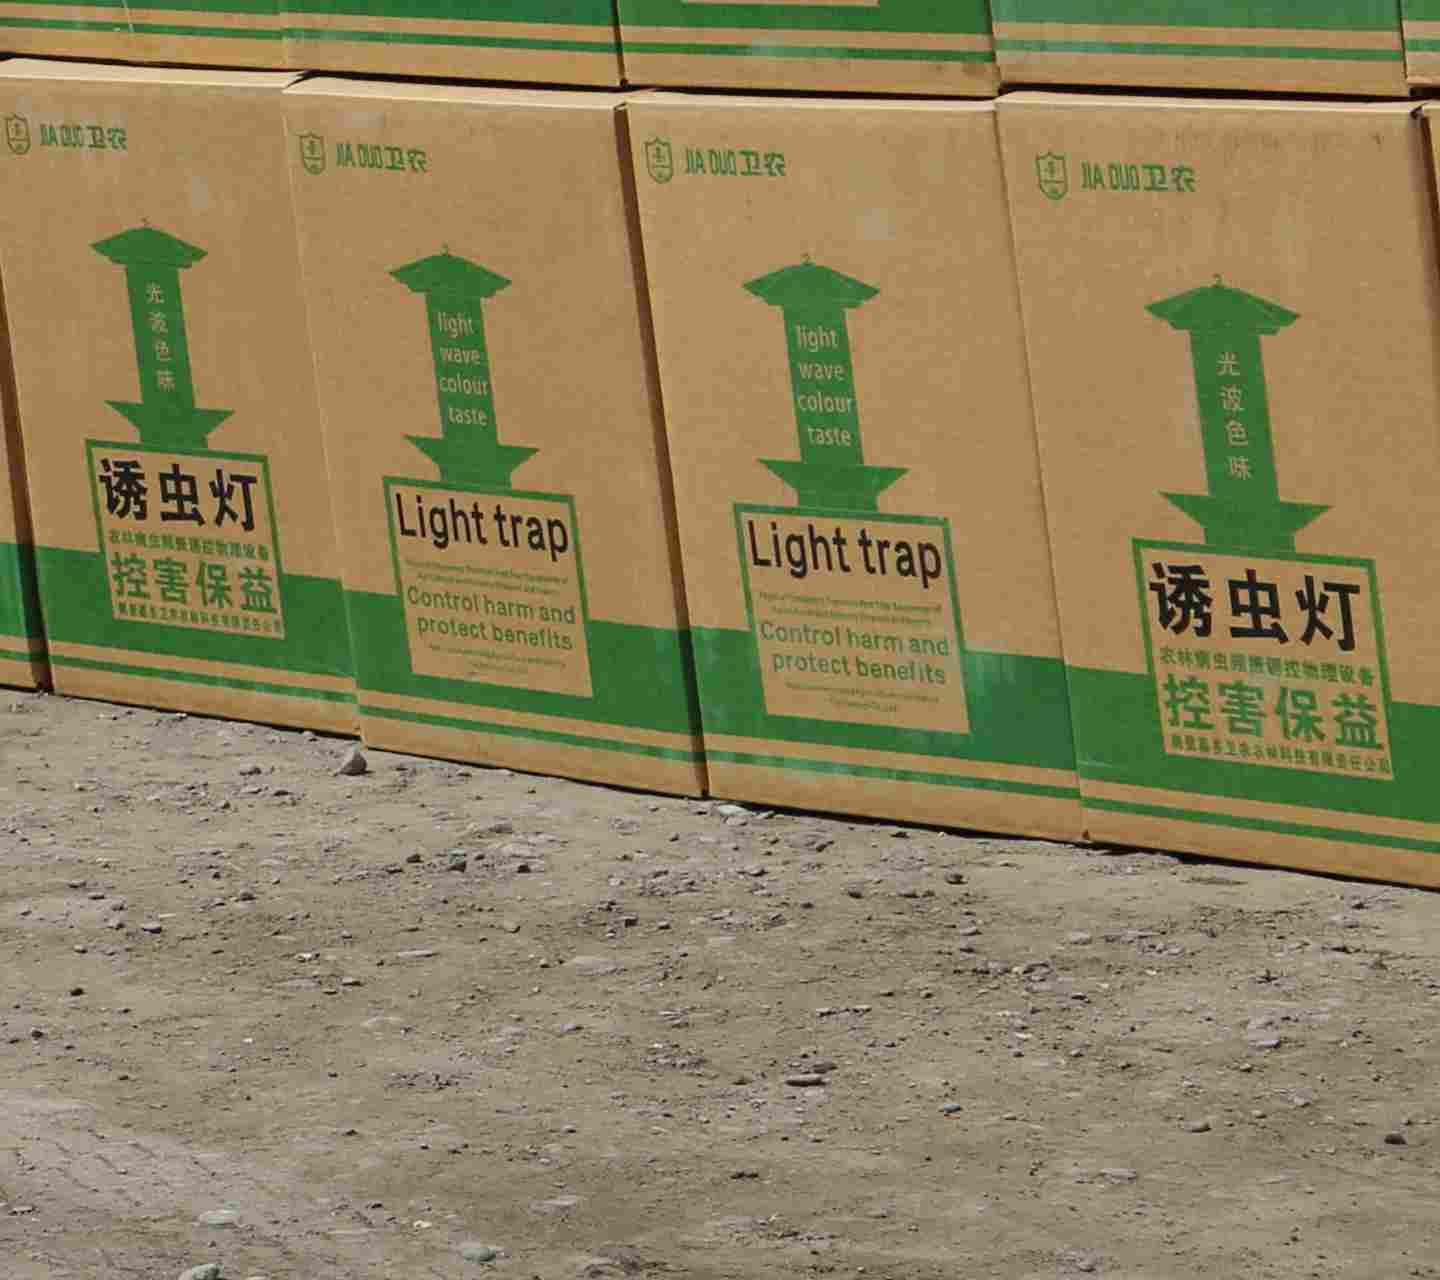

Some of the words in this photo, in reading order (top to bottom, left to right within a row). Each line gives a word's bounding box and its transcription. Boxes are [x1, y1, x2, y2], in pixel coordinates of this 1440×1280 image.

[86, 127, 126, 150] 卫农
[387, 148, 427, 172] 卫农
[740, 150, 786, 178] 卫农
[1143, 163, 1195, 193] 卫农
[438, 312, 474, 338] light
[797, 326, 837, 353] light
[440, 346, 481, 365] wave
[438, 374, 488, 397] colour
[800, 361, 844, 382] wave
[448, 406, 487, 427] taste
[798, 391, 853, 415] colour
[1216, 351, 1251, 480] 光波色味
[807, 424, 851, 447] taste
[99, 457, 257, 531] 诱虫灯
[396, 493, 485, 549] Light
[492, 507, 569, 560] trap
[747, 519, 851, 581] Light
[858, 527, 942, 588] trap
[112, 553, 277, 614] 控害保益
[407, 586, 478, 615] Control
[484, 594, 535, 623] harm
[539, 601, 576, 626] and
[1150, 563, 1360, 650] 诱虫灯
[417, 615, 487, 643] protect
[492, 623, 573, 652] benefits
[759, 621, 841, 647] Control
[847, 627, 903, 653] harm
[909, 634, 949, 657] and
[772, 654, 850, 676] protect
[855, 657, 946, 685] benefits
[1164, 673, 1384, 751] 控害保益
